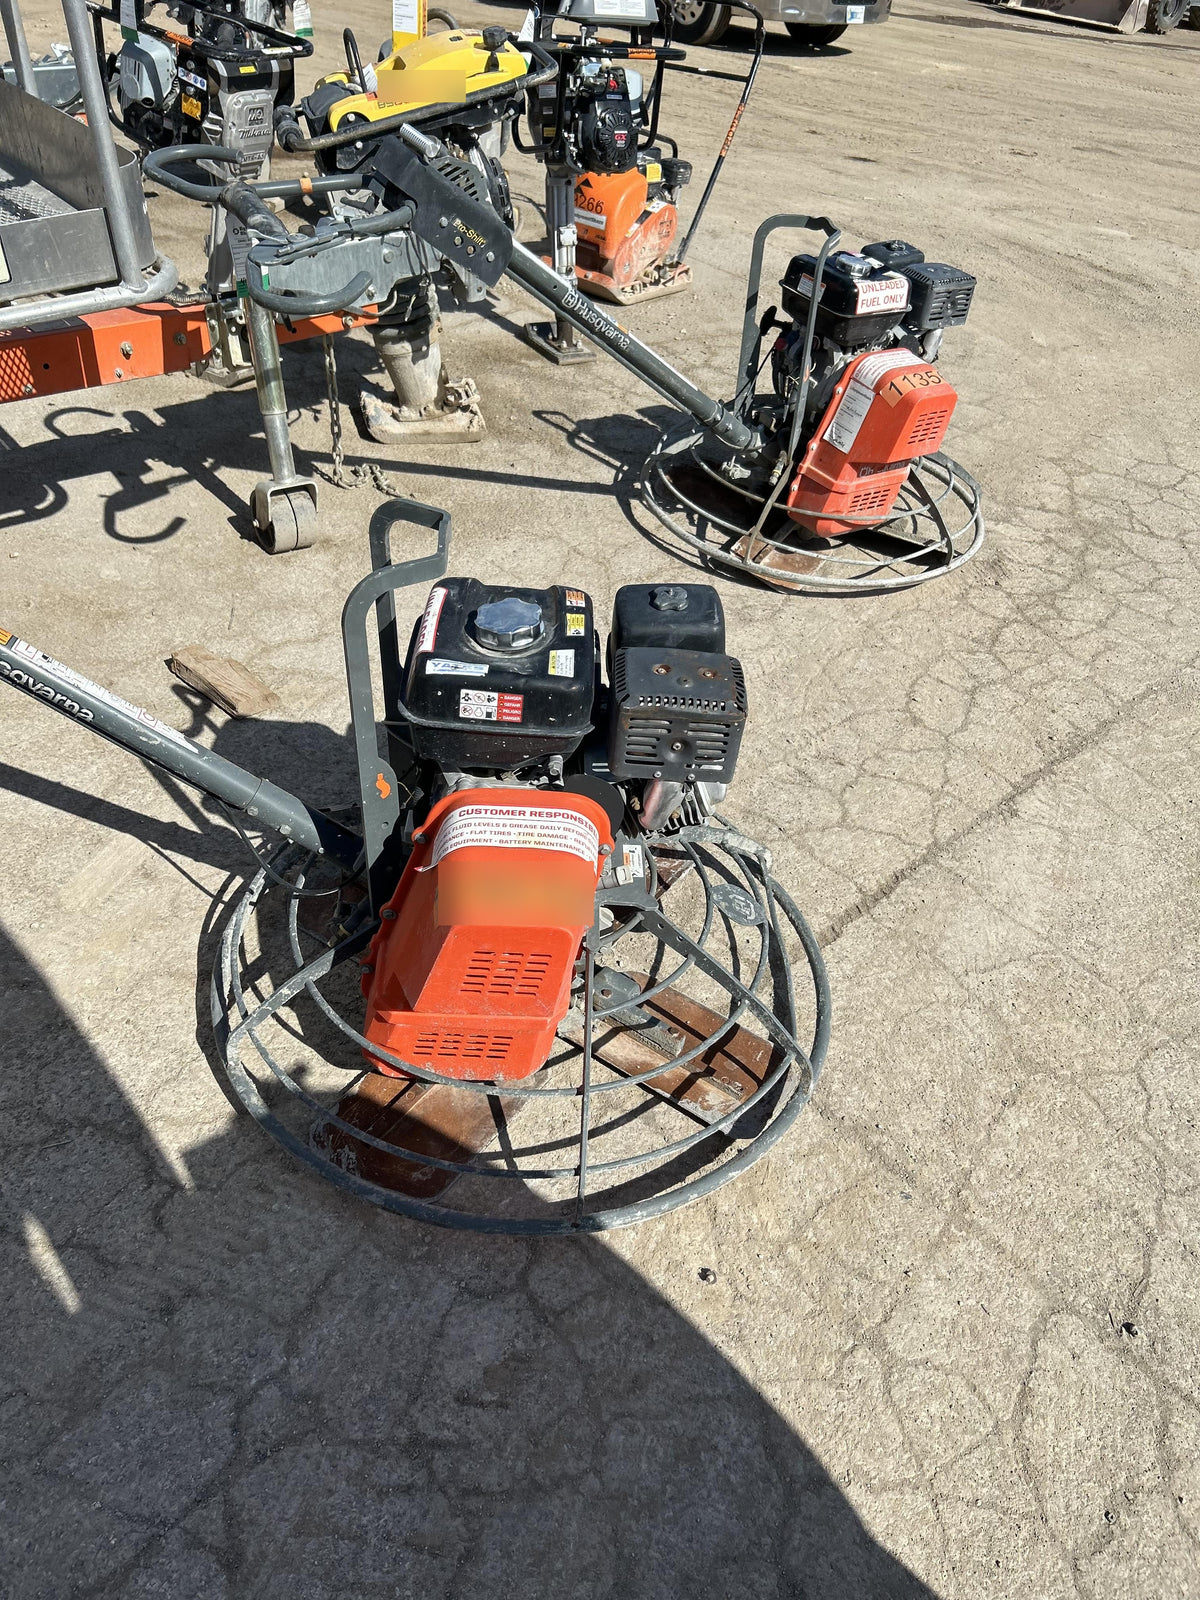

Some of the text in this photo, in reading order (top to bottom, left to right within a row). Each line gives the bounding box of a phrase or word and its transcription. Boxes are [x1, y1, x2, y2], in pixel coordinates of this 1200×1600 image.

[860, 279, 906, 294] UNLEADED
[860, 293, 905, 309] FUEL ONLY
[574, 298, 631, 350] Husqvarna
[458, 808, 527, 818] CUSTOMER
[452, 822, 472, 832] FLUID
[563, 827, 590, 840] BEFORE
[450, 839, 493, 848] EQUIPMENT
[534, 841, 585, 855] MAINTENANCE
